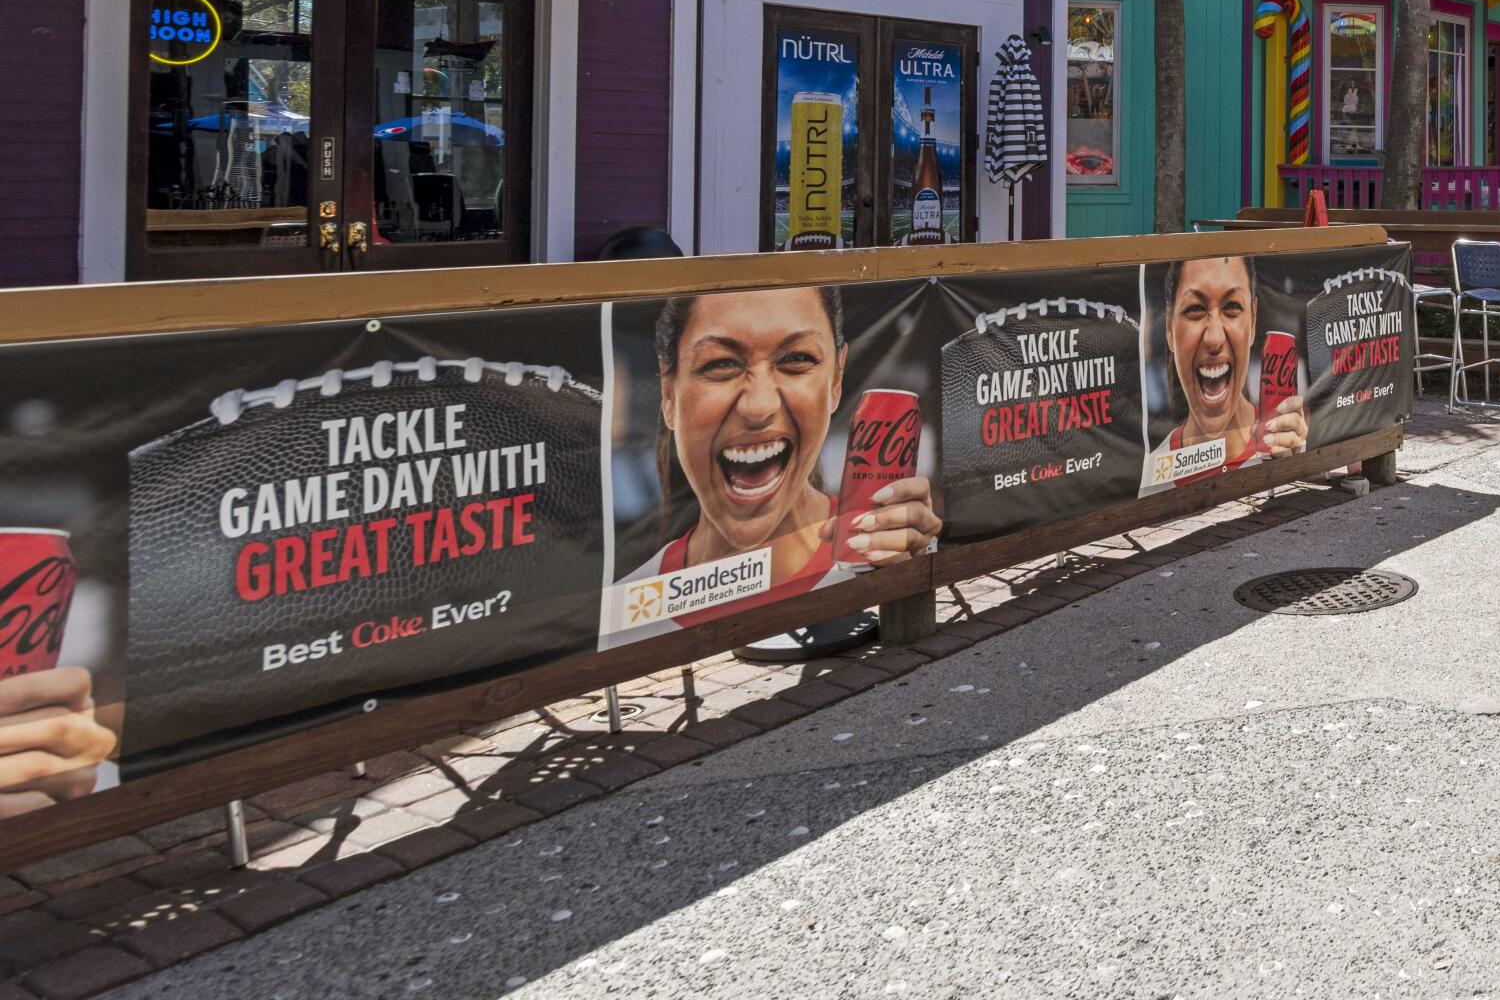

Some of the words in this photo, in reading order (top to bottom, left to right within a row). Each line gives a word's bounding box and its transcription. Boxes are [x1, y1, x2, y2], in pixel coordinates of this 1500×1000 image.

[900, 60, 955, 77] ULTRA
[908, 48, 944, 59] Michelob
[324, 141, 332, 176] PUSH
[914, 210, 941, 220] ULTRA
[1346, 290, 1383, 317] TACKLE
[1017, 328, 1080, 365] TACKLE
[1325, 319, 1357, 346] GAME
[1358, 315, 1377, 340] DAY
[1379, 311, 1402, 336] WITH
[1331, 342, 1368, 377] GREAT
[1369, 336, 1400, 367] TASTE
[976, 368, 1034, 405] GAME
[1038, 363, 1069, 396] DAY
[1072, 356, 1116, 390] WITH
[1336, 393, 1355, 408] Best
[1373, 383, 1394, 398] Ever?
[321, 404, 467, 466] TACKLE
[982, 401, 1054, 446] GREAT
[1058, 389, 1113, 432] TASTE
[994, 469, 1028, 490] Best
[1030, 463, 1063, 481] Coke
[1065, 452, 1103, 474] Ever?
[1174, 443, 1223, 469] Sandestin
[219, 471, 350, 538] GAME
[362, 460, 440, 515] DAY
[452, 441, 548, 497] WITH
[852, 472, 873, 480] ZERO
[876, 472, 905, 480] SUGAR
[235, 525, 390, 602] GREAT
[405, 493, 537, 568] TASTE
[667, 600, 687, 614] Golf
[689, 597, 706, 608] and
[708, 589, 734, 602] Beach
[736, 580, 763, 595] Resort
[668, 558, 764, 600] Sandestin
[261, 630, 344, 671] Best
[351, 610, 426, 649] Coke
[430, 589, 512, 630] Ever?
